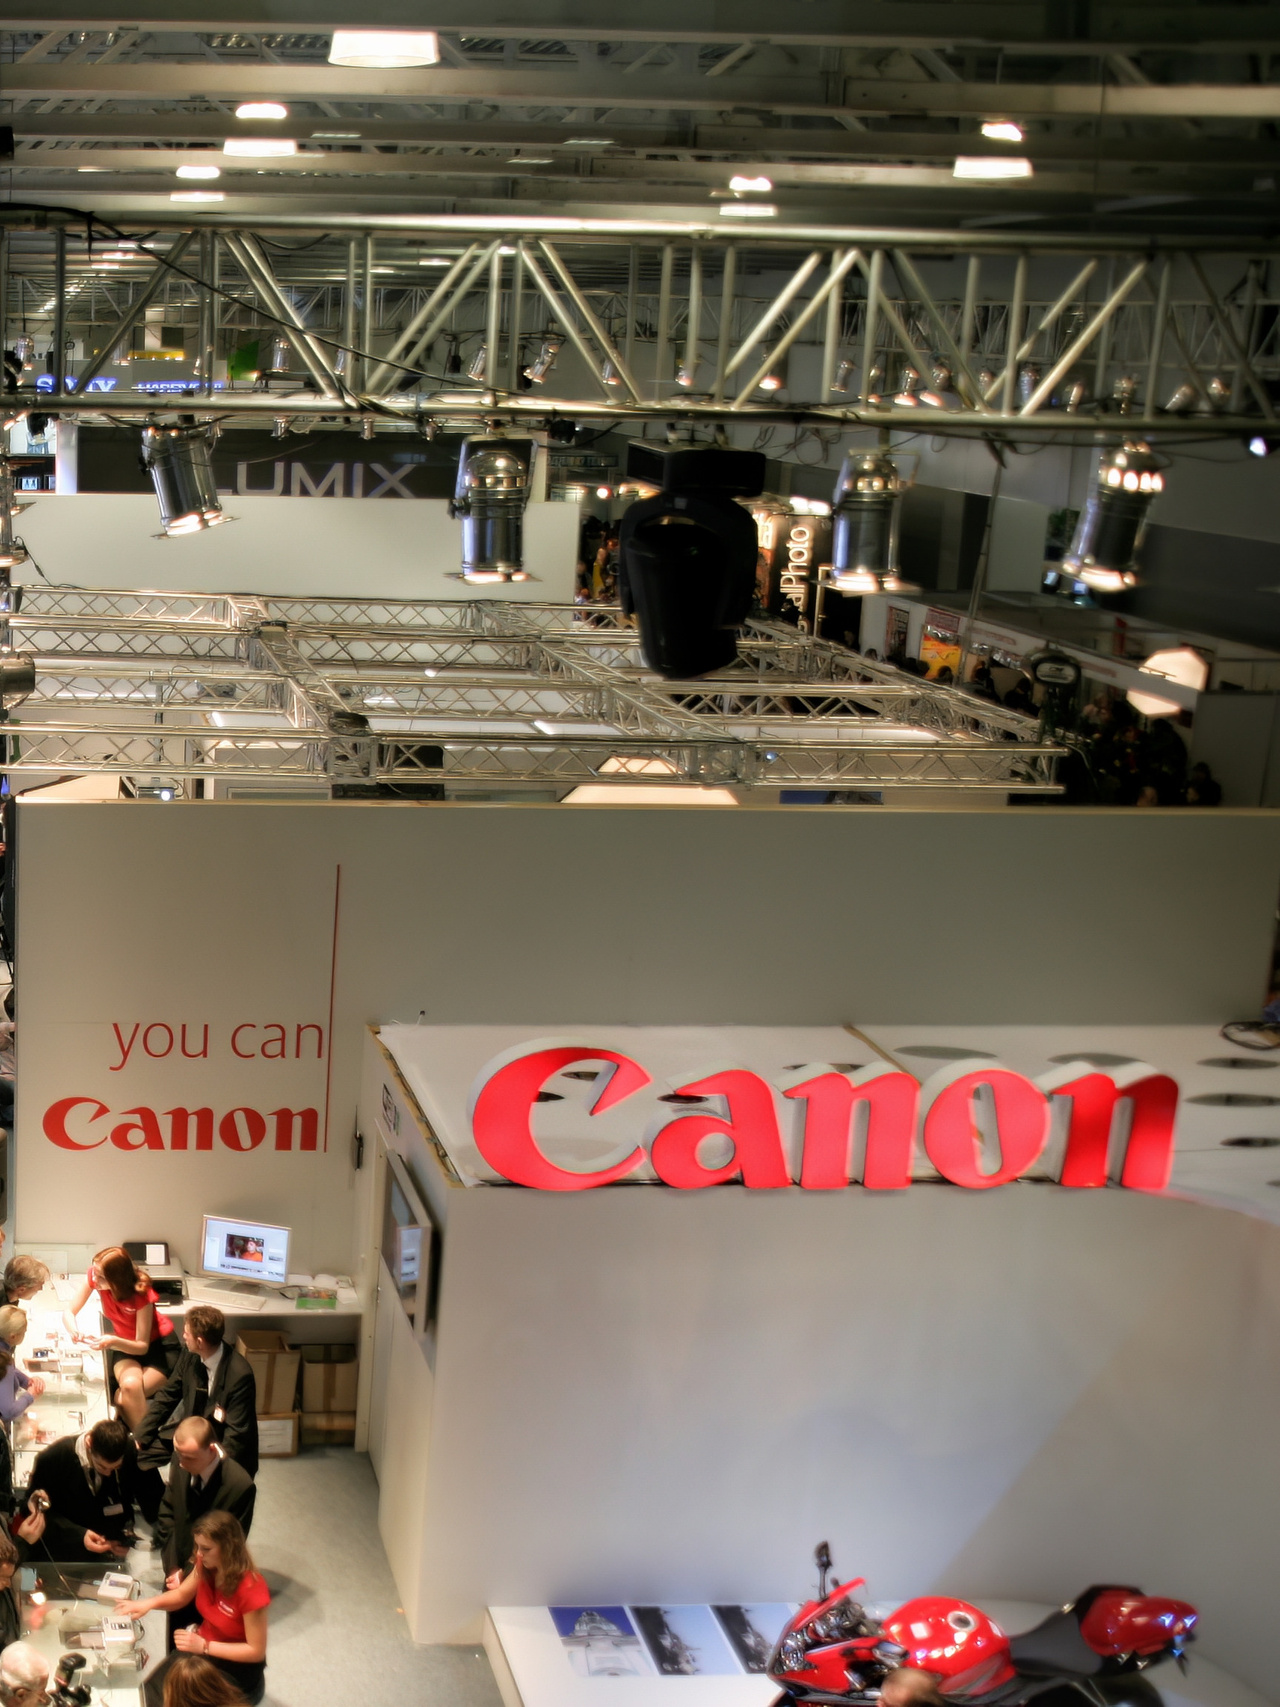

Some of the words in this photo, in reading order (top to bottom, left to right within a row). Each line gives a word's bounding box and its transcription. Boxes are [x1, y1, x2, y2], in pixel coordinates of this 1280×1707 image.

[109, 1022, 210, 1071] you
[230, 1022, 324, 1059] can
[42, 1096, 319, 1151] Canon
[472, 1042, 1180, 1191] Canon
